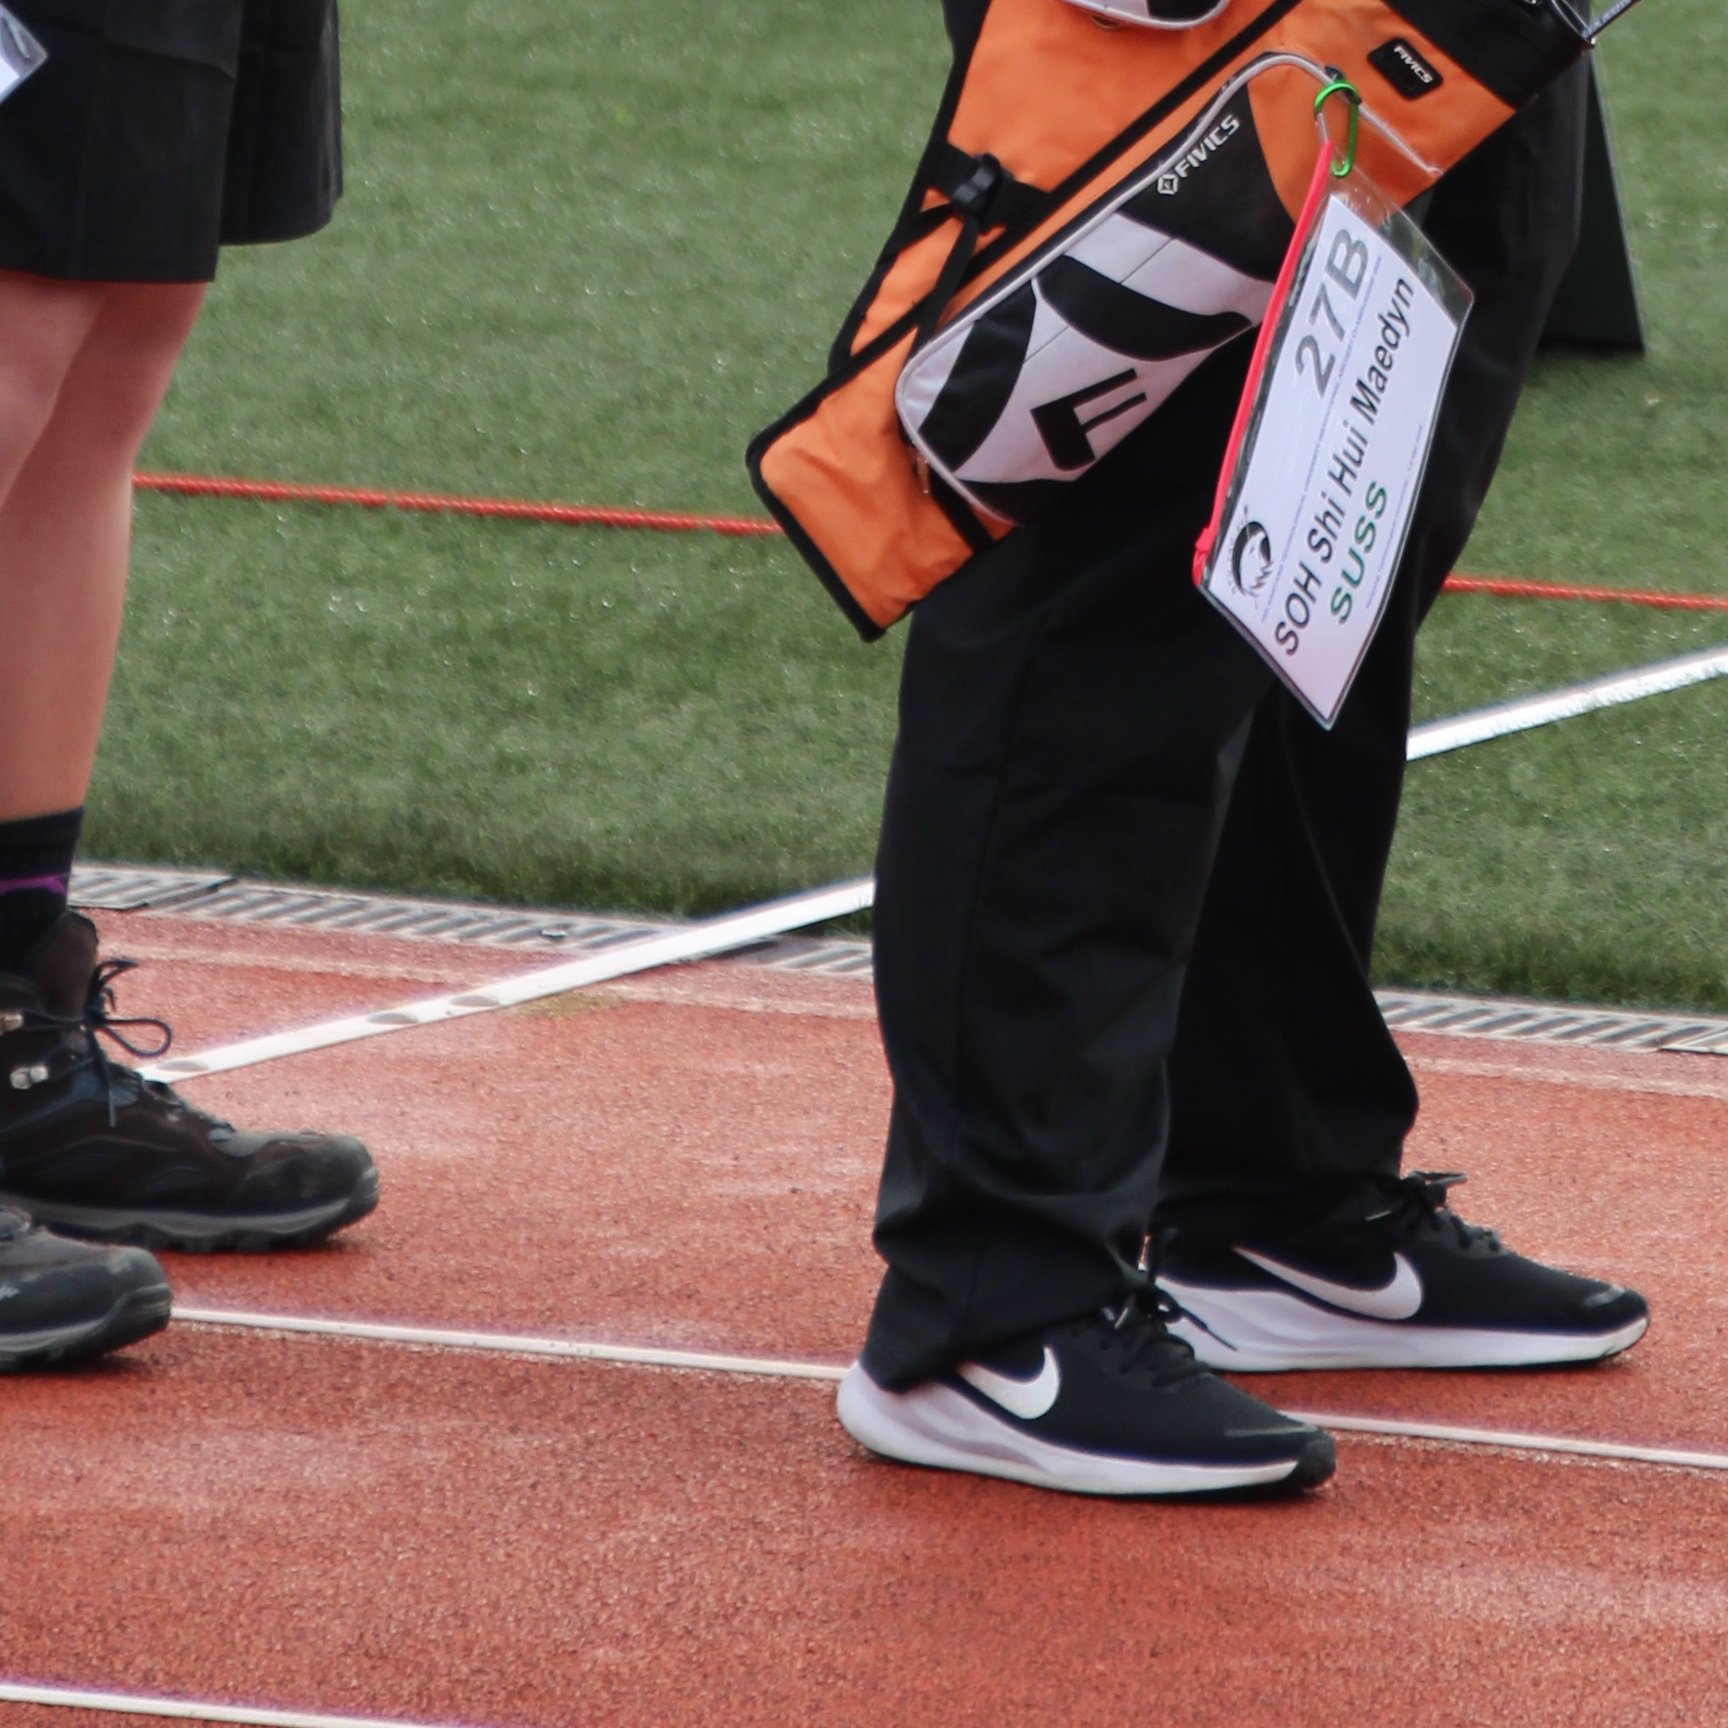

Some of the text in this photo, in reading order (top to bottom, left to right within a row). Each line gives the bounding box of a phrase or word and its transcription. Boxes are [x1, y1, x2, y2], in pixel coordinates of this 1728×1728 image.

[1394, 46, 1433, 84] FIVICS
[1178, 113, 1241, 178] FIVICS
[1295, 227, 1370, 401] 27B
[1350, 277, 1415, 422] Maedyn
[1326, 418, 1371, 497] Hui
[1307, 497, 1346, 566] Shi
[1328, 480, 1388, 625] SUSS
[1275, 562, 1324, 656] SOH
